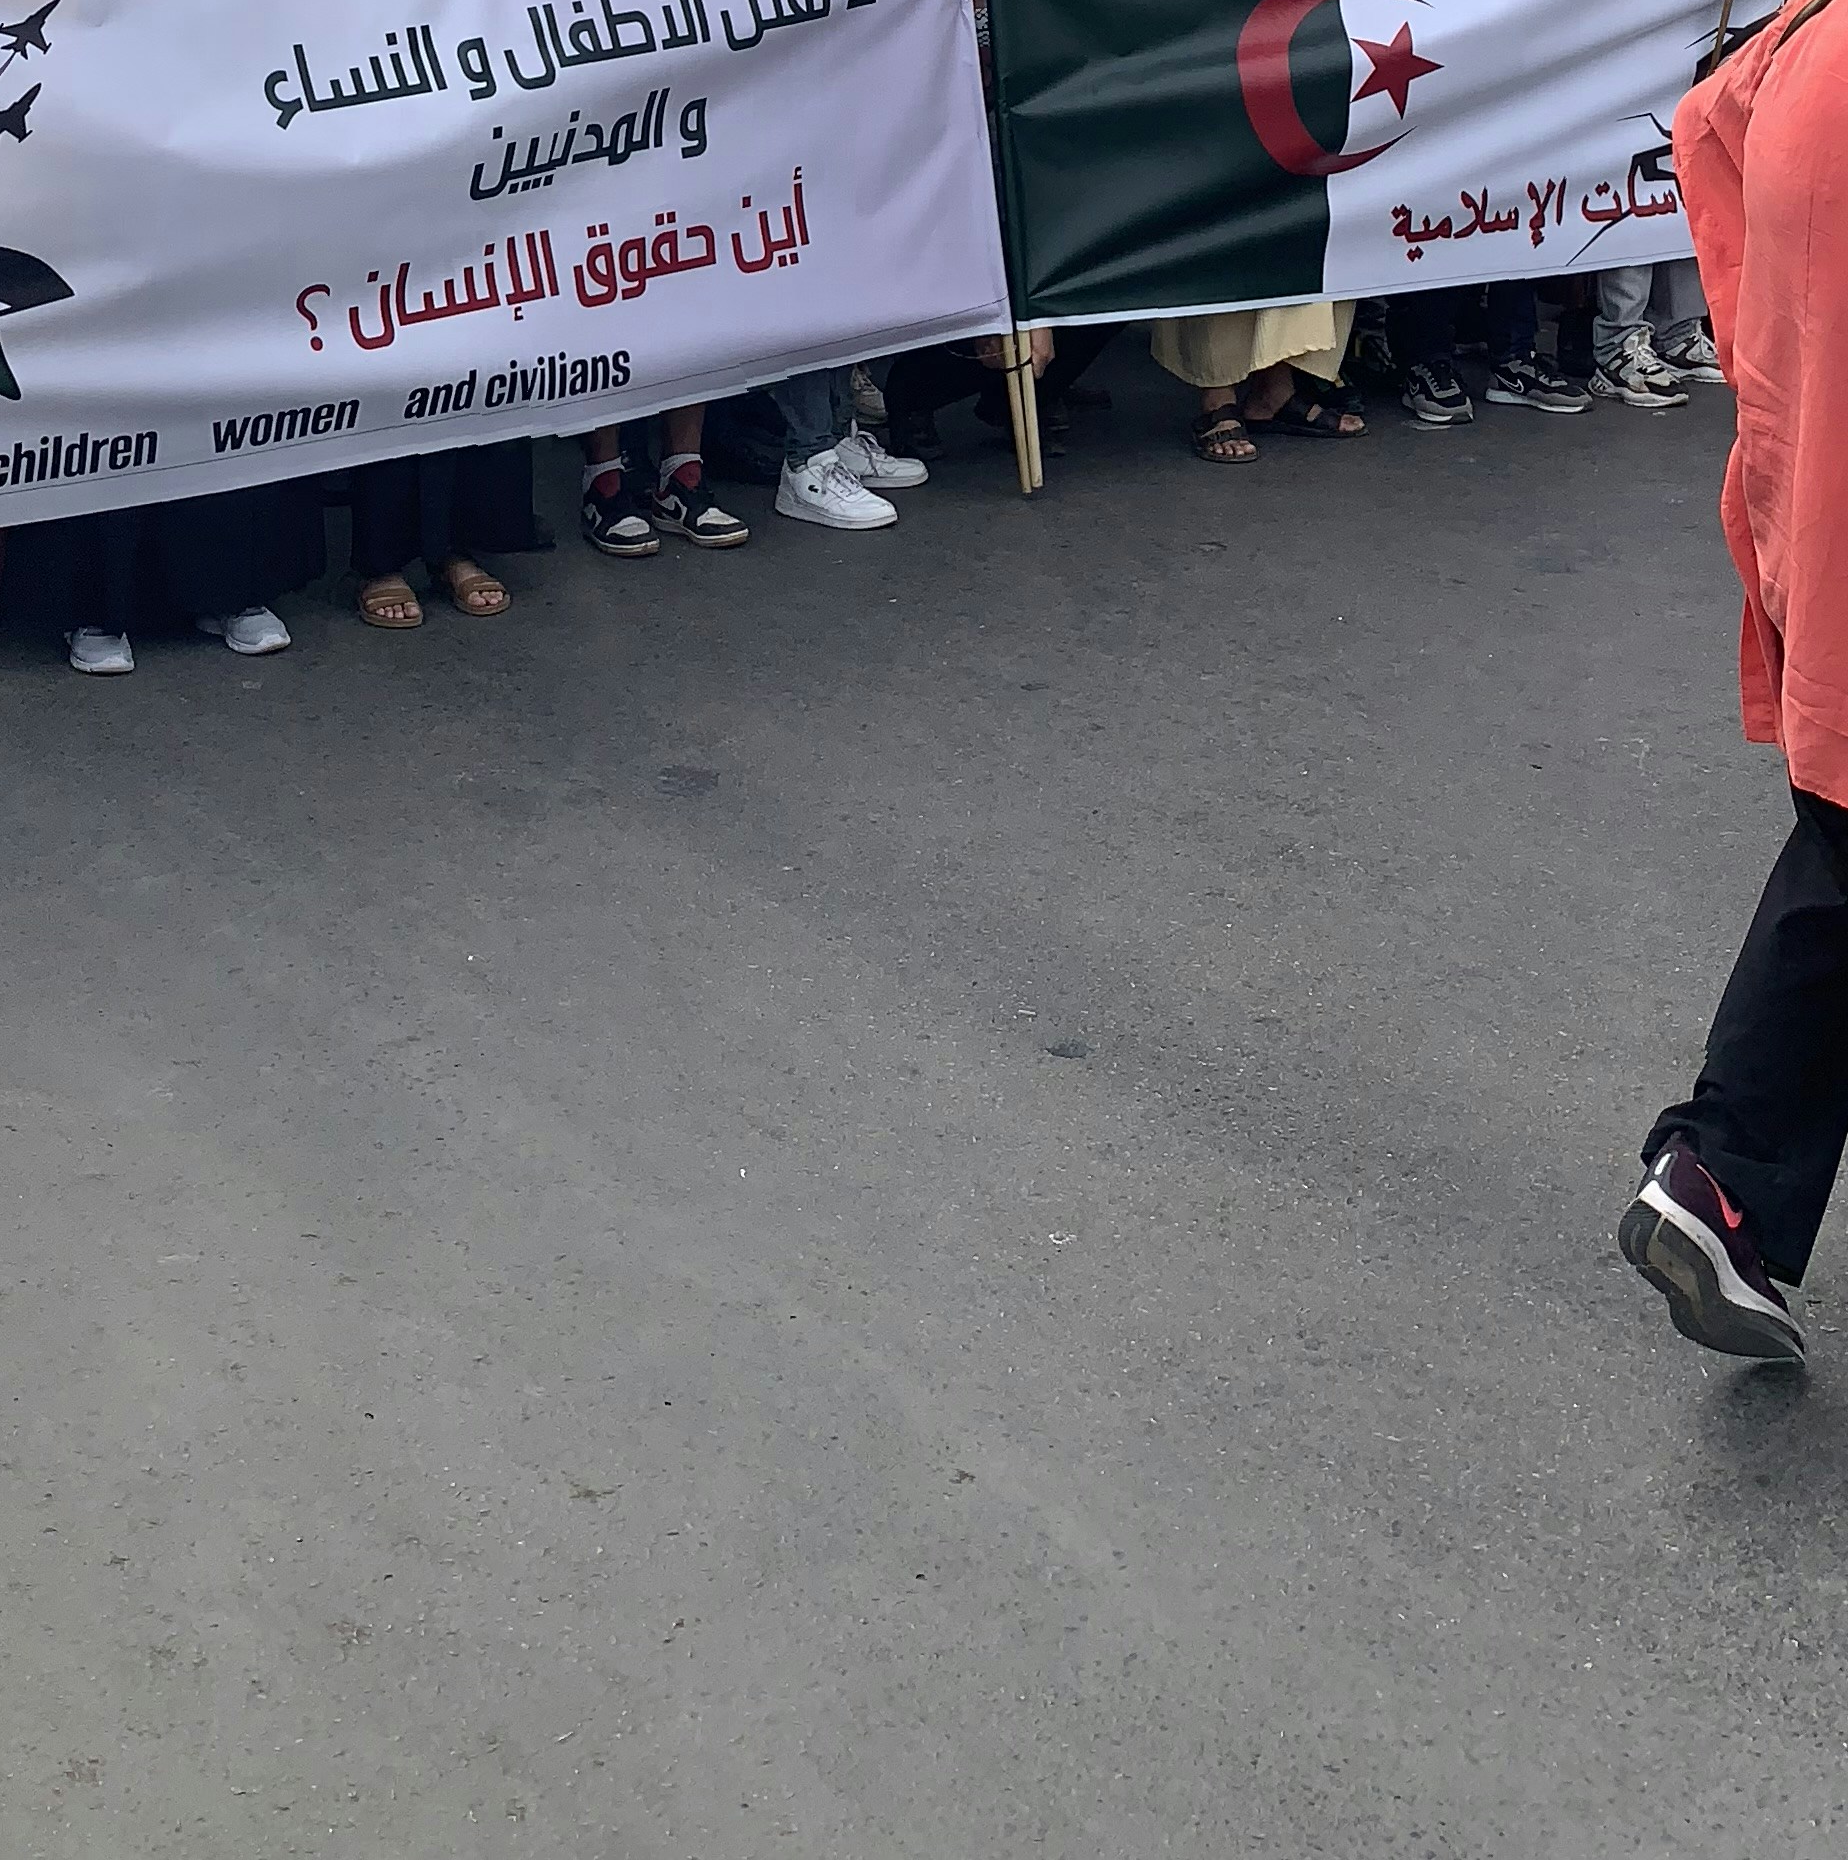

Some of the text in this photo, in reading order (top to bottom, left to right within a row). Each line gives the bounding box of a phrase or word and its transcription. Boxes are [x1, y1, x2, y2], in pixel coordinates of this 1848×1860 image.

[263, 24, 449, 131] النساء
[455, 36, 497, 101] و
[469, 87, 709, 201] و المدنيين
[573, 211, 717, 309] حقوق
[731, 165, 811, 275] أين
[1390, 176, 1567, 263] الإسلامية
[347, 229, 560, 351] الإنسان
[212, 397, 361, 454] women
[404, 369, 477, 420] and
[484, 349, 631, 409] civilians
